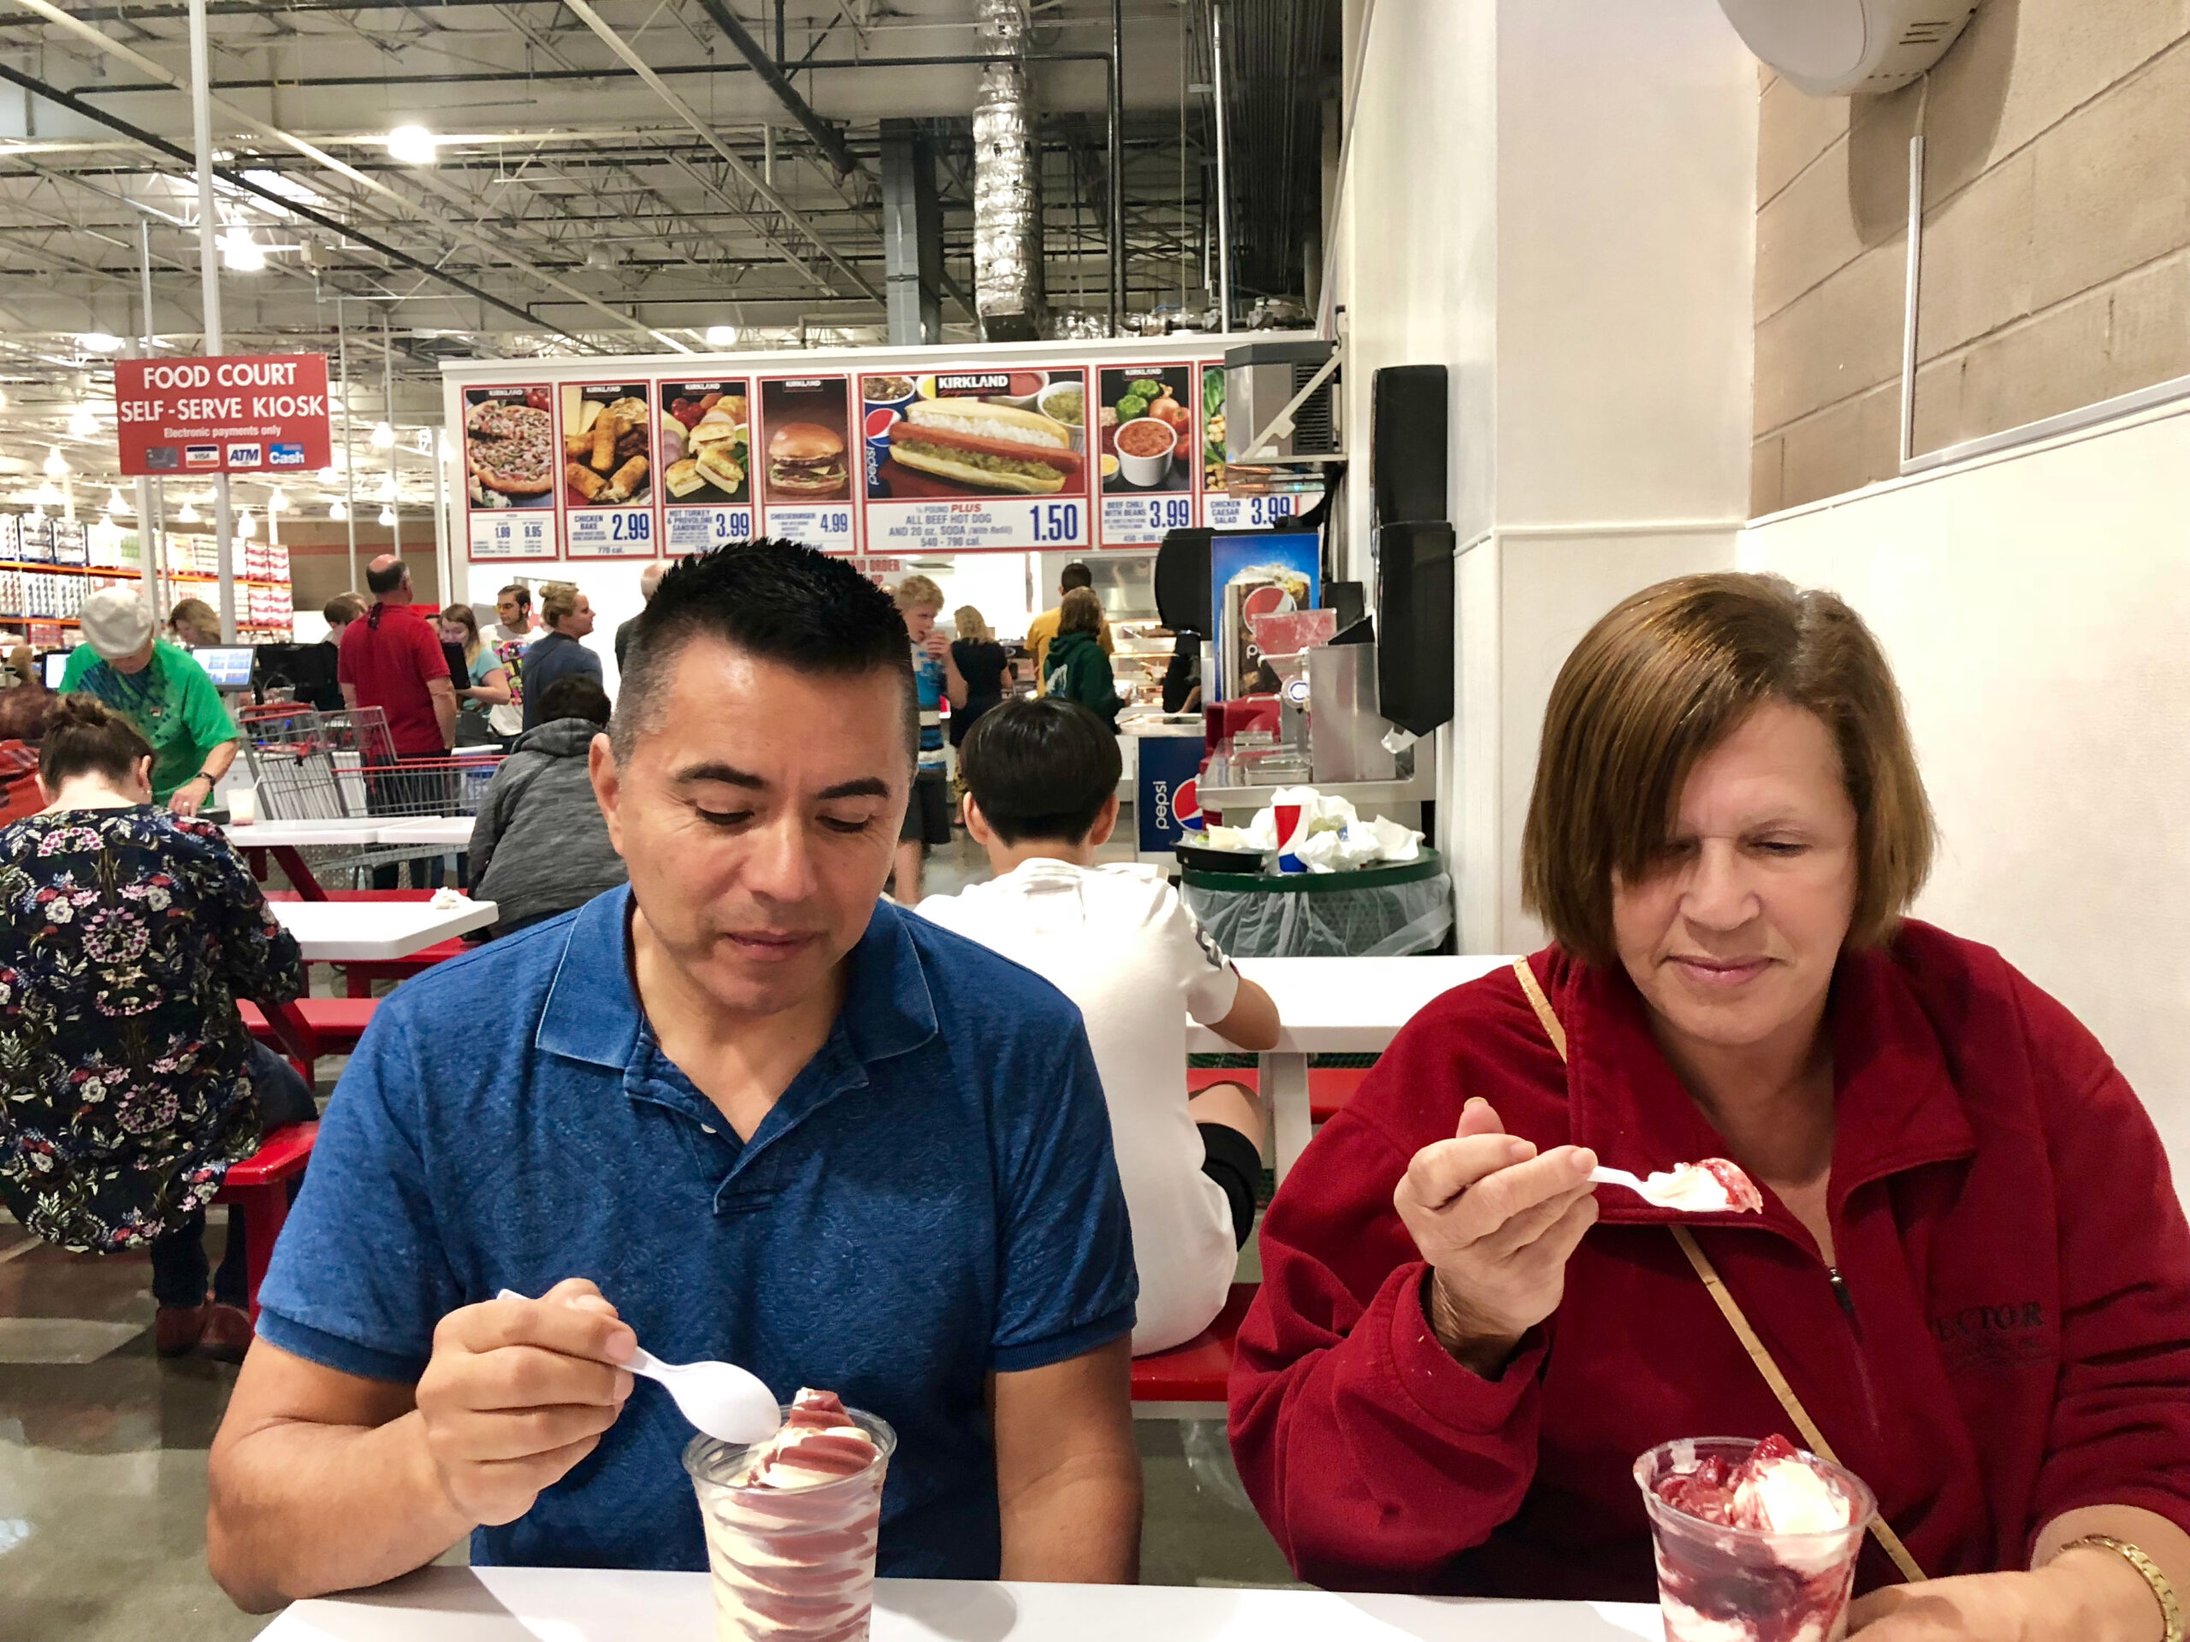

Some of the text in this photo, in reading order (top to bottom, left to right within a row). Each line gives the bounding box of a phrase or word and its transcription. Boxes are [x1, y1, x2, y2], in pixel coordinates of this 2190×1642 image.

[143, 363, 297, 389] FOOD COURT
[1124, 368, 1162, 376] KIRKLAND
[938, 375, 1008, 389] KIRKLAND
[253, 395, 325, 418] KIOSK
[164, 425, 282, 439] Electronic payments only
[230, 449, 259, 462] ATM
[269, 451, 305, 465] Cash
[866, 447, 880, 485] pepsi
[951, 504, 982, 513] PLUS
[1107, 501, 1124, 509] BEEF
[1251, 496, 1290, 525] 3.99
[906, 514, 992, 525] ALL BEEF HOT DOG
[1104, 509, 1122, 517] WITH
[1150, 499, 1189, 528] 3.99
[612, 513, 650, 540] 2.99
[716, 513, 750, 537] 3.99
[820, 513, 848, 533] 4.99
[1029, 504, 1078, 541] 1.50
[889, 527, 907, 536] AND
[911, 527, 922, 536] 20
[925, 528, 937, 536] oz.
[940, 526, 965, 535] SODA
[920, 537, 937, 547] 540
[966, 536, 982, 546] cal.
[870, 560, 900, 572] ORDER
[1153, 781, 1170, 830] pepsi
